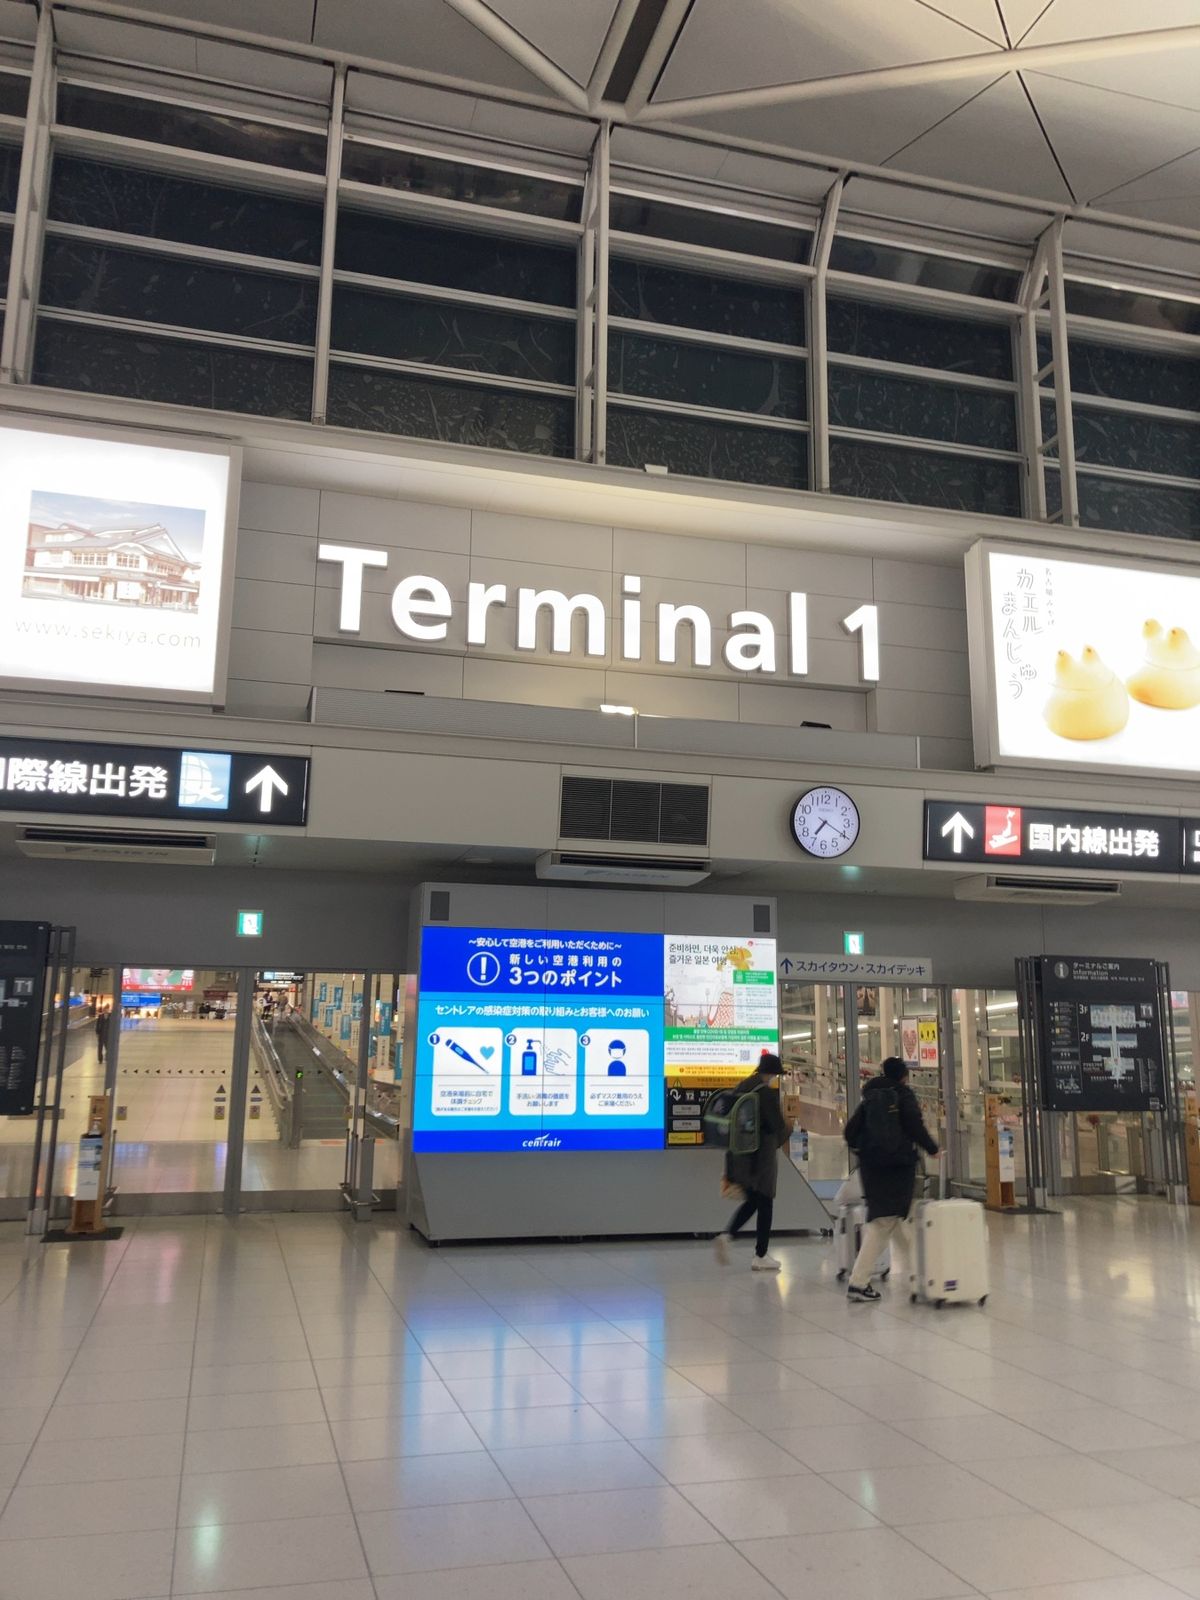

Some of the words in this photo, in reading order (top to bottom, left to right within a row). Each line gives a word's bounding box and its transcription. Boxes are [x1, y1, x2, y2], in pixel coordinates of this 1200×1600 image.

[1016, 568, 1043, 634] カエル
[317, 543, 808, 676] Terminal
[843, 604, 881, 682] 1
[15, 618, 201, 648] www.sekiya.com
[0, 757, 168, 798] 際線出発
[821, 794, 831, 805] 12
[801, 804, 812, 815] 10
[841, 806, 848, 816] 2
[798, 816, 806, 826] 9
[843, 818, 850, 828] 3
[802, 827, 809, 837] 8
[810, 836, 817, 847] 7
[820, 840, 827, 850] 6
[831, 838, 838, 848] 5
[1029, 822, 1160, 858] 国内線出発
[704, 944, 719, 954] 더욱
[509, 953, 622, 968] 新しい空港利用の
[669, 954, 692, 965] 즐거운
[694, 955, 710, 965] 일본
[712, 956, 727, 966] 여행
[796, 961, 926, 976] スカイタウン・スカイデッキ
[509, 966, 622, 988] 3つのポイント
[14, 980, 33, 994] T1
[1079, 1005, 1088, 1015] 3F
[1140, 1005, 1153, 1016] T1
[1080, 1032, 1089, 1042] 2F
[522, 1133, 562, 1148] centrair
